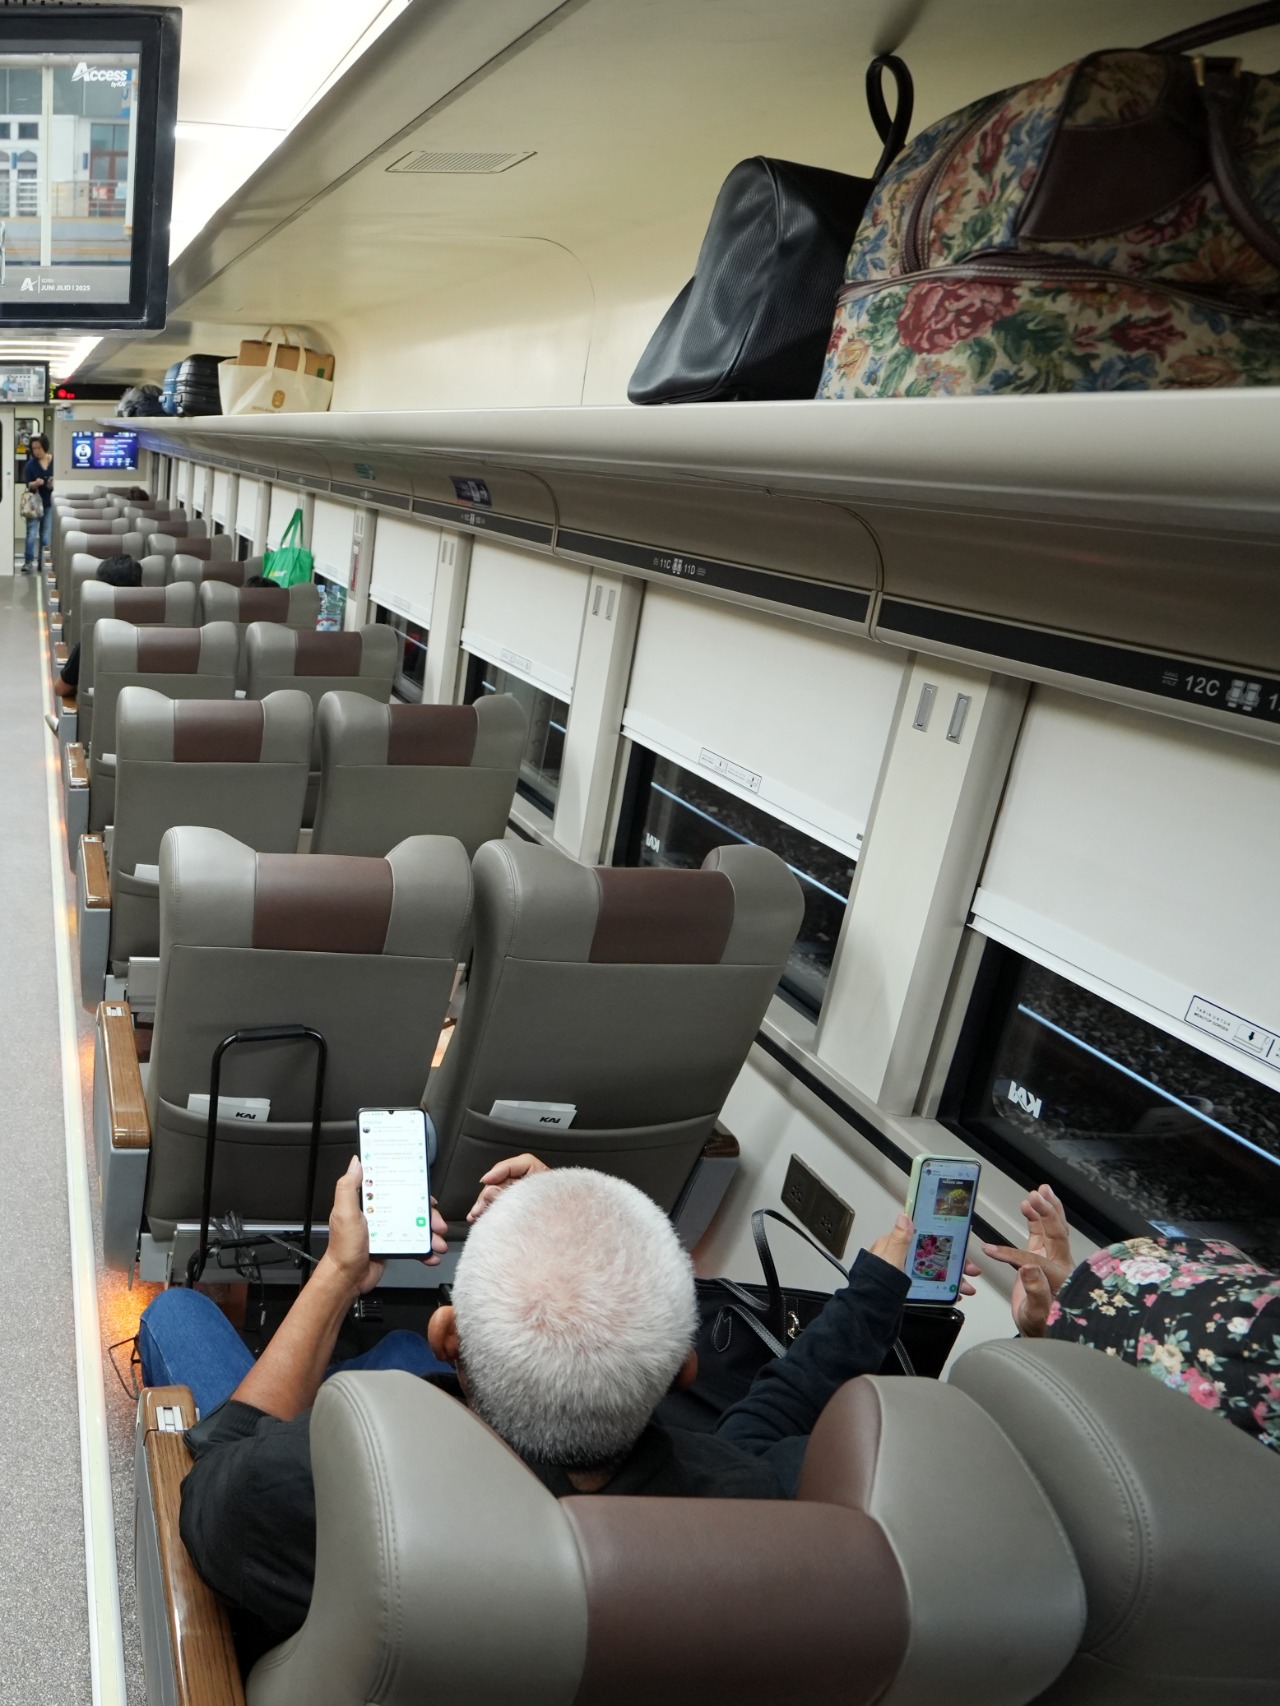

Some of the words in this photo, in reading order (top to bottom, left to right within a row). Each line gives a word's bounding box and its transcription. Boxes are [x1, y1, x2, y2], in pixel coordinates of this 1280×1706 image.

[71, 62, 128, 81] Access
[660, 558, 671, 569] 11C
[684, 563, 696, 575] 11D
[1185, 675, 1220, 697] 12C
